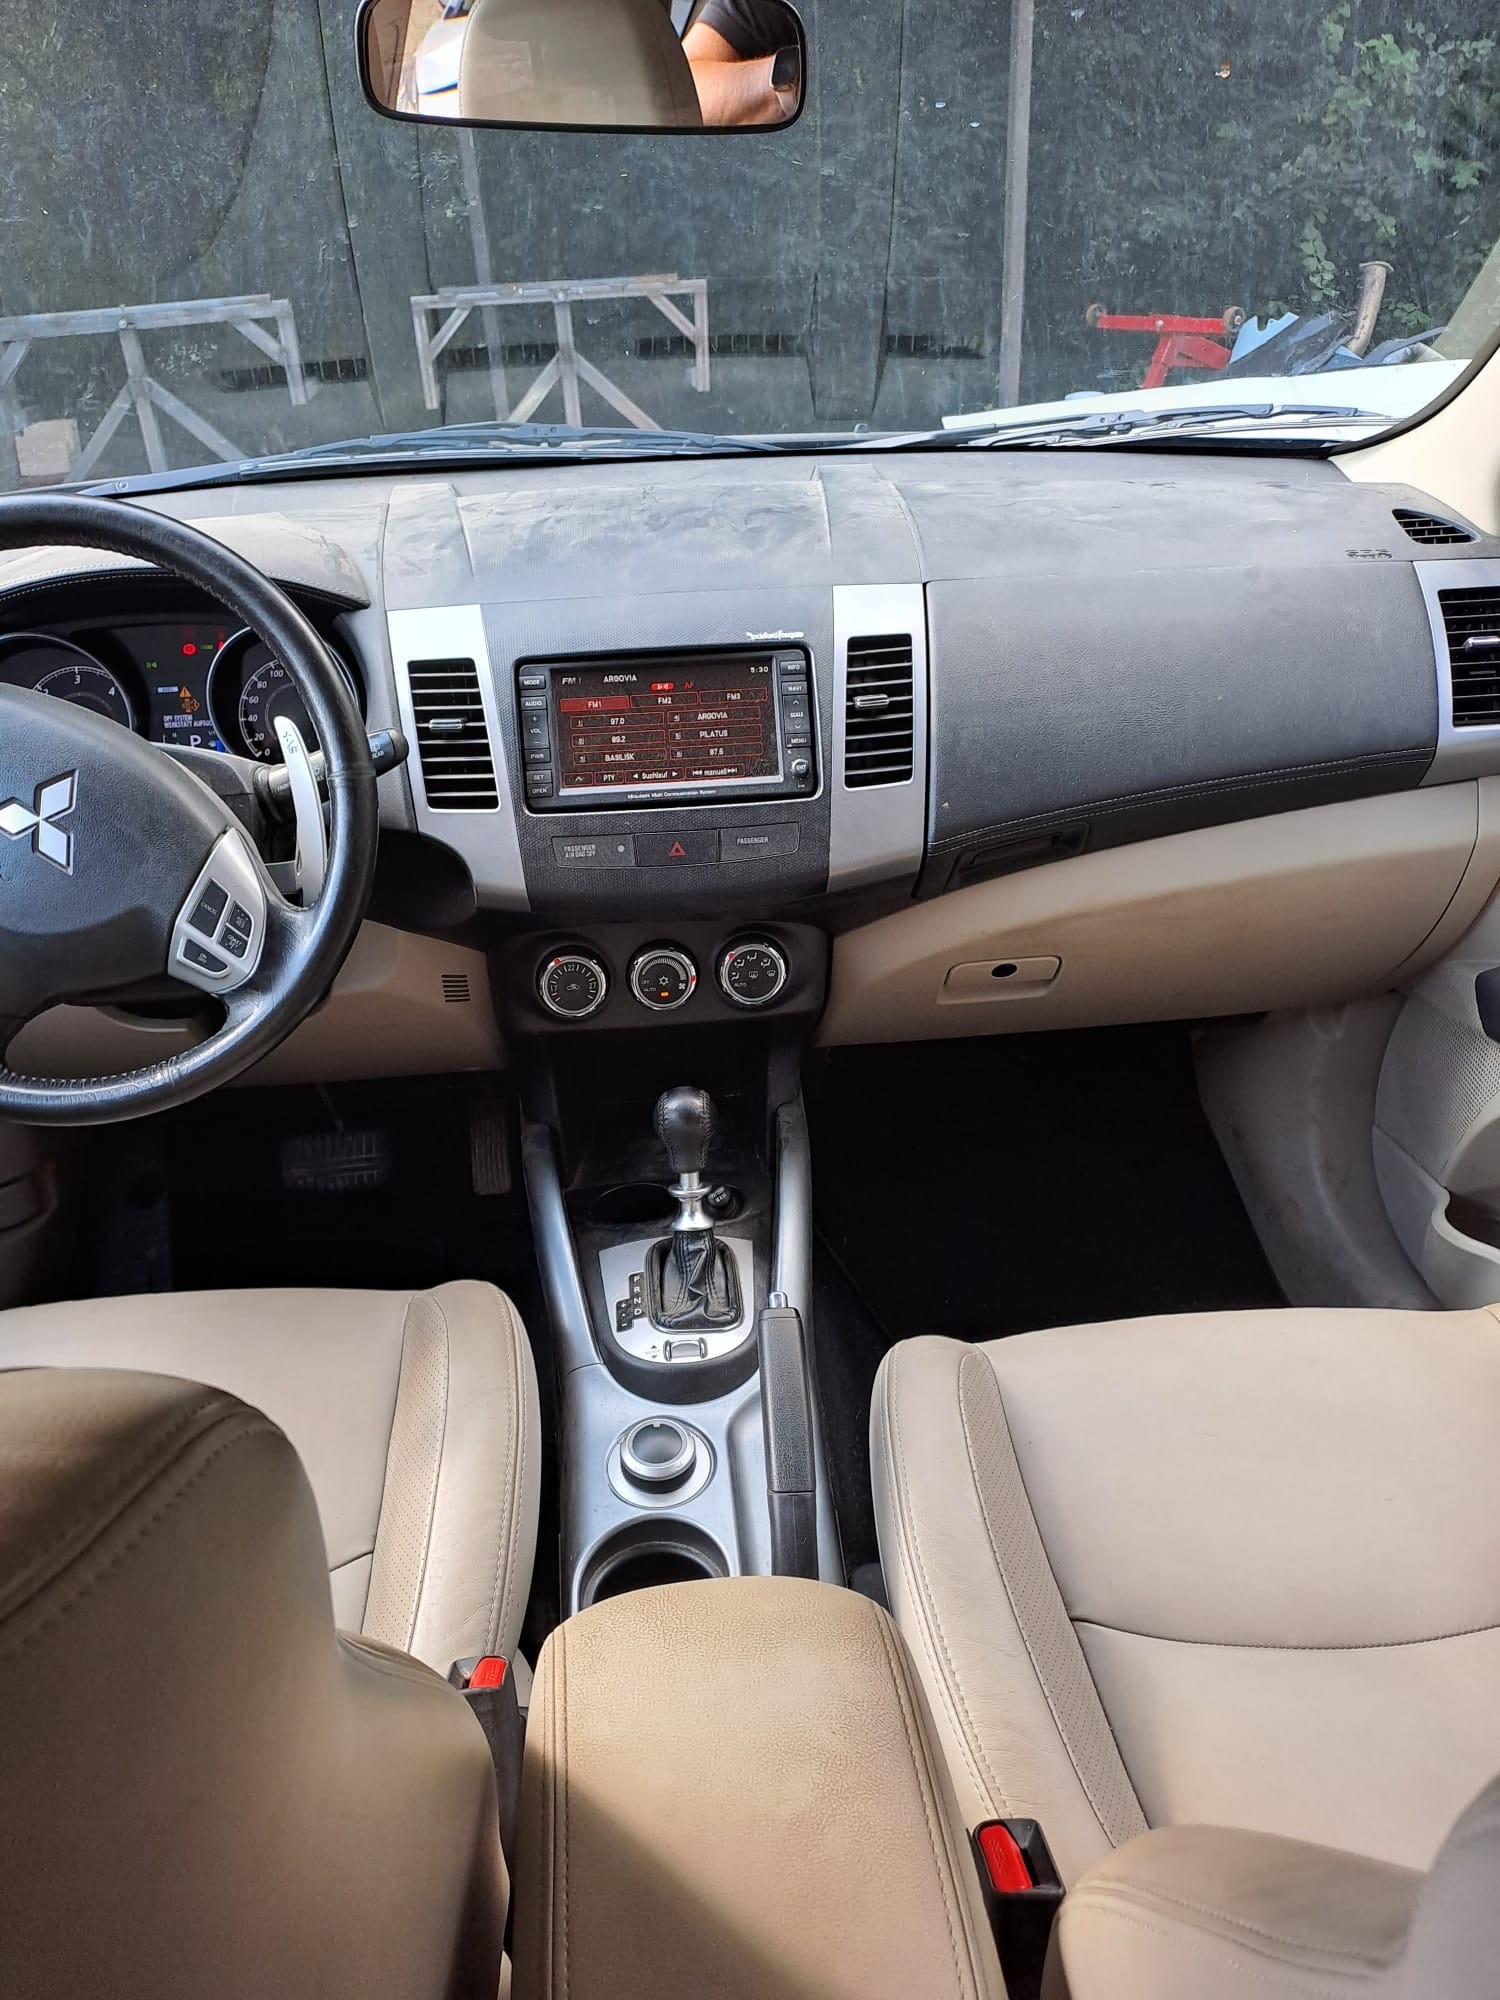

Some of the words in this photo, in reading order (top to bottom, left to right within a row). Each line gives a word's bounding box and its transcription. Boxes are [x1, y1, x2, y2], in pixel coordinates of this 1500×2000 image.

[269, 669, 284, 678] 100
[74, 674, 81, 685] 3
[603, 674, 638, 683] ARGOVIA
[256, 680, 268, 689] 80
[108, 686, 115, 697] 4
[726, 692, 741, 700] FM3
[248, 695, 259, 704] 60
[587, 700, 602, 708] FM1
[657, 696, 672, 705] FM2
[247, 714, 258, 722] 40
[254, 732, 265, 741] 20
[699, 729, 729, 738] PILATUS
[190, 735, 202, 747] P
[264, 748, 271, 756] 0
[604, 752, 635, 762] BASILISK
[603, 774, 616, 782] PTY
[633, 1275, 640, 1283] P
[633, 1286, 641, 1294] R
[633, 1296, 641, 1305] N
[634, 1308, 642, 1316] D
